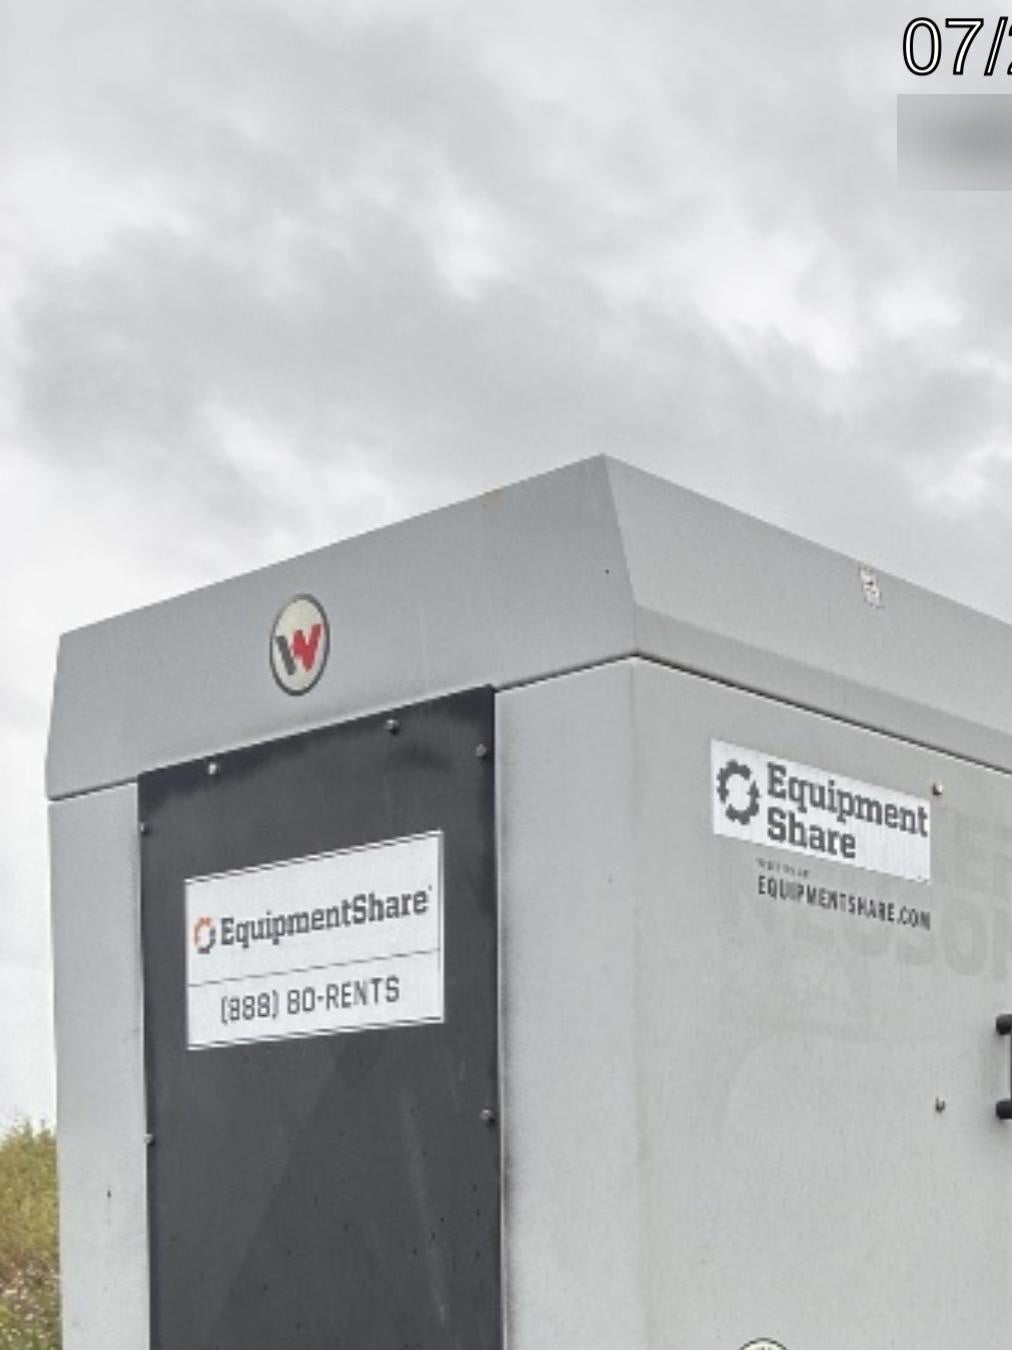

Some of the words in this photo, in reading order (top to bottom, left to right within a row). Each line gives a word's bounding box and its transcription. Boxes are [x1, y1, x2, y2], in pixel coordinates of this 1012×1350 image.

[766, 762, 928, 838] Equipment
[766, 808, 857, 859] Share
[220, 889, 430, 950] EquipmentShare
[757, 875, 932, 931] EQUIPMENTSHARE.COM
[220, 989, 280, 1025] (888)
